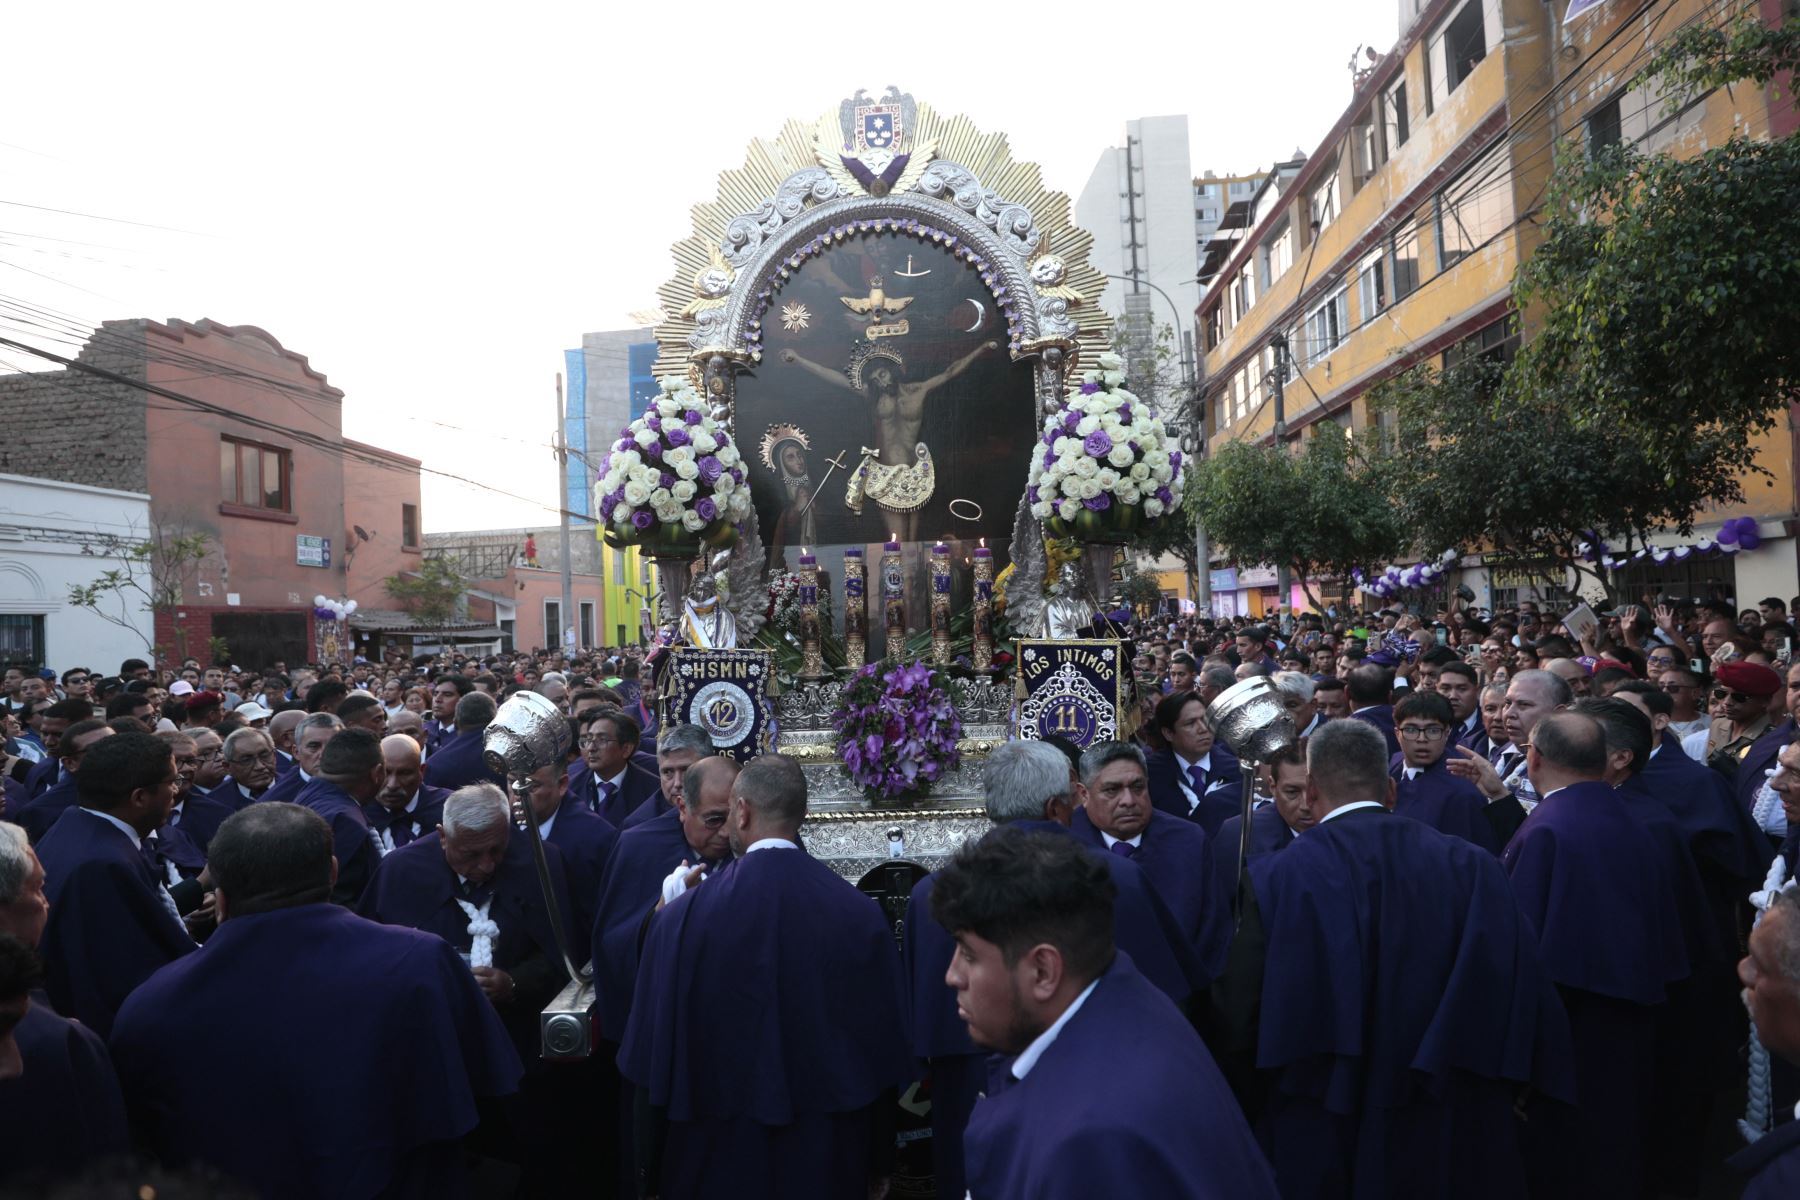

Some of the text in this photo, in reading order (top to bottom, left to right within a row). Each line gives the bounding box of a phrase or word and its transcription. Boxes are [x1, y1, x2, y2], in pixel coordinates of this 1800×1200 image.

[800, 578, 863, 605] H S
[889, 573, 900, 584] 12
[976, 581, 993, 601] N
[693, 662, 747, 679] HSMN
[1024, 648, 1114, 681] LOS INTIMOS
[710, 702, 735, 728] 12
[1055, 705, 1079, 732] 11
